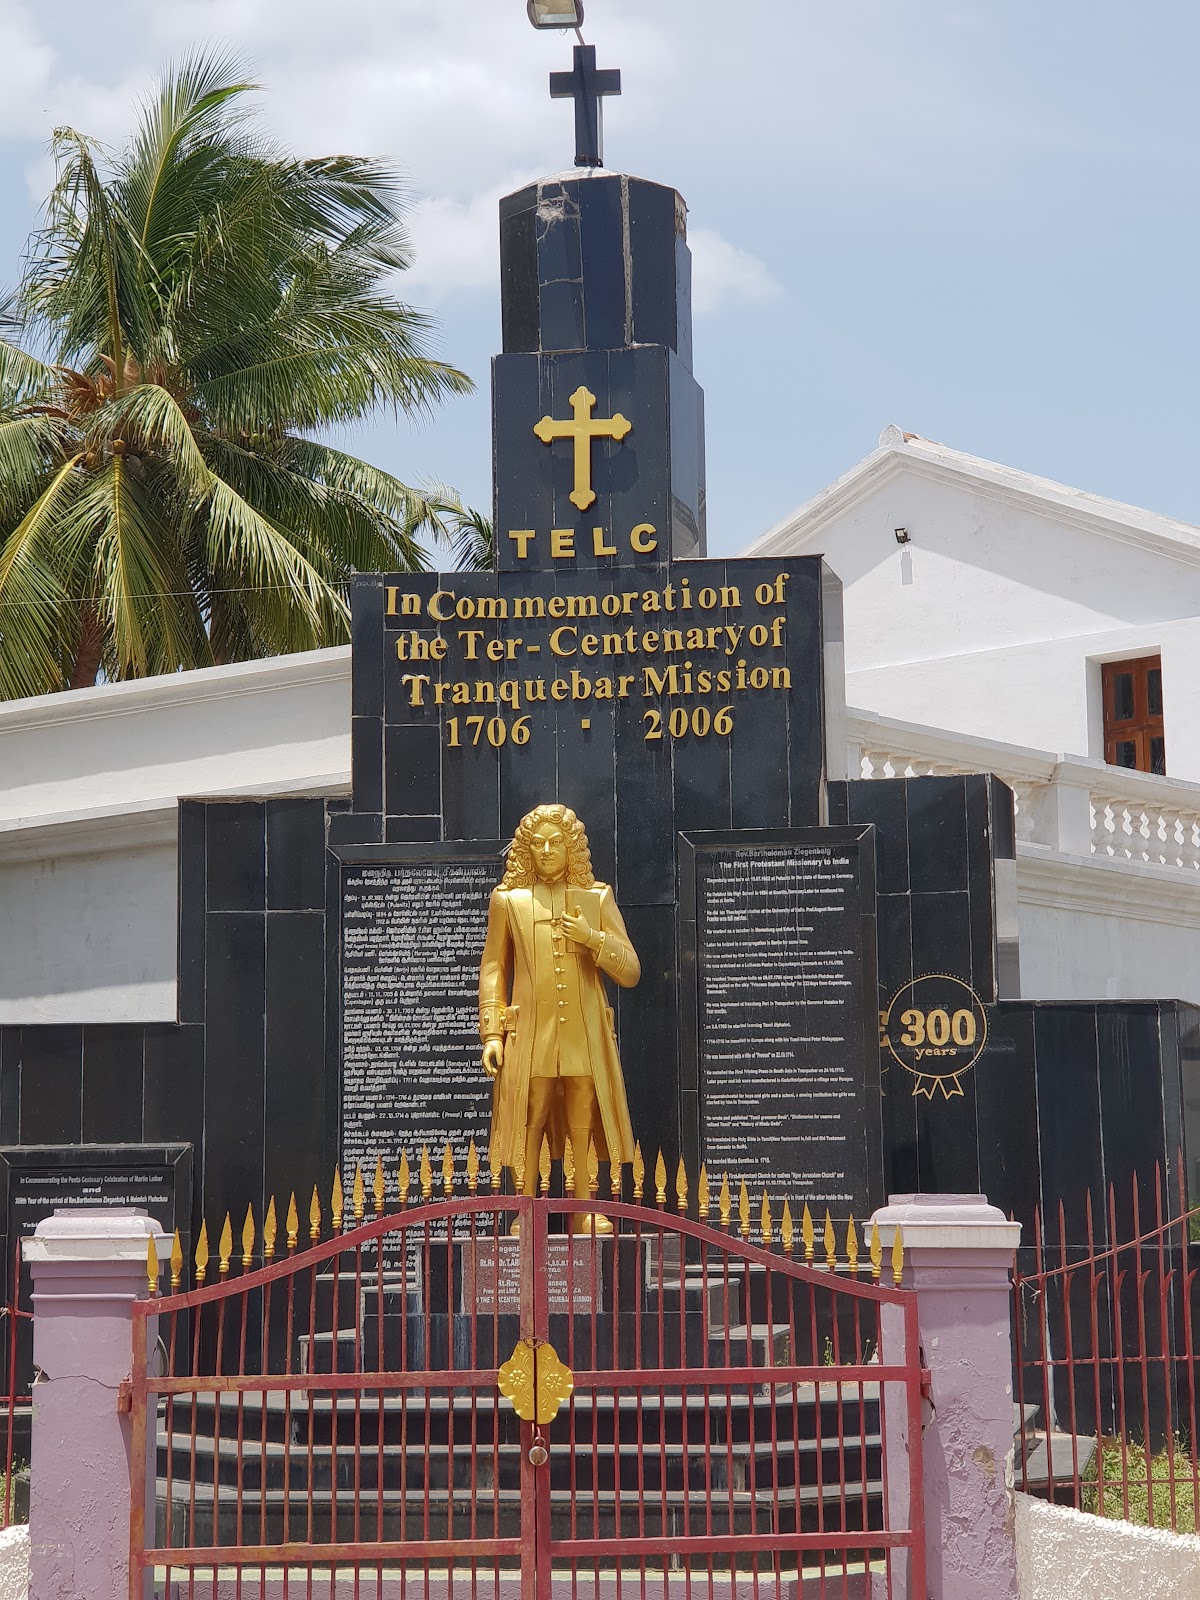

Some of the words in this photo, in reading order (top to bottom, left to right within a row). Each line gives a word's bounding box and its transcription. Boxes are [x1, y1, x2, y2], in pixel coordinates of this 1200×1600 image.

[509, 523, 658, 559] TELC
[384, 586, 421, 616] In
[428, 578, 741, 622] Commemoration
[755, 573, 791, 605] of
[396, 631, 448, 661] the
[549, 625, 745, 656] Centenary
[751, 617, 786, 648] of
[401, 671, 634, 710] Tranquebar
[642, 659, 792, 698] Mission
[446, 715, 531, 748] 1706
[643, 705, 735, 741] 2006
[719, 861, 732, 869] The
[733, 861, 749, 869] First
[750, 860, 785, 868] Protestant
[786, 858, 822, 867] Missionary
[900, 1009, 976, 1046] 300
[915, 1048, 957, 1061] years
